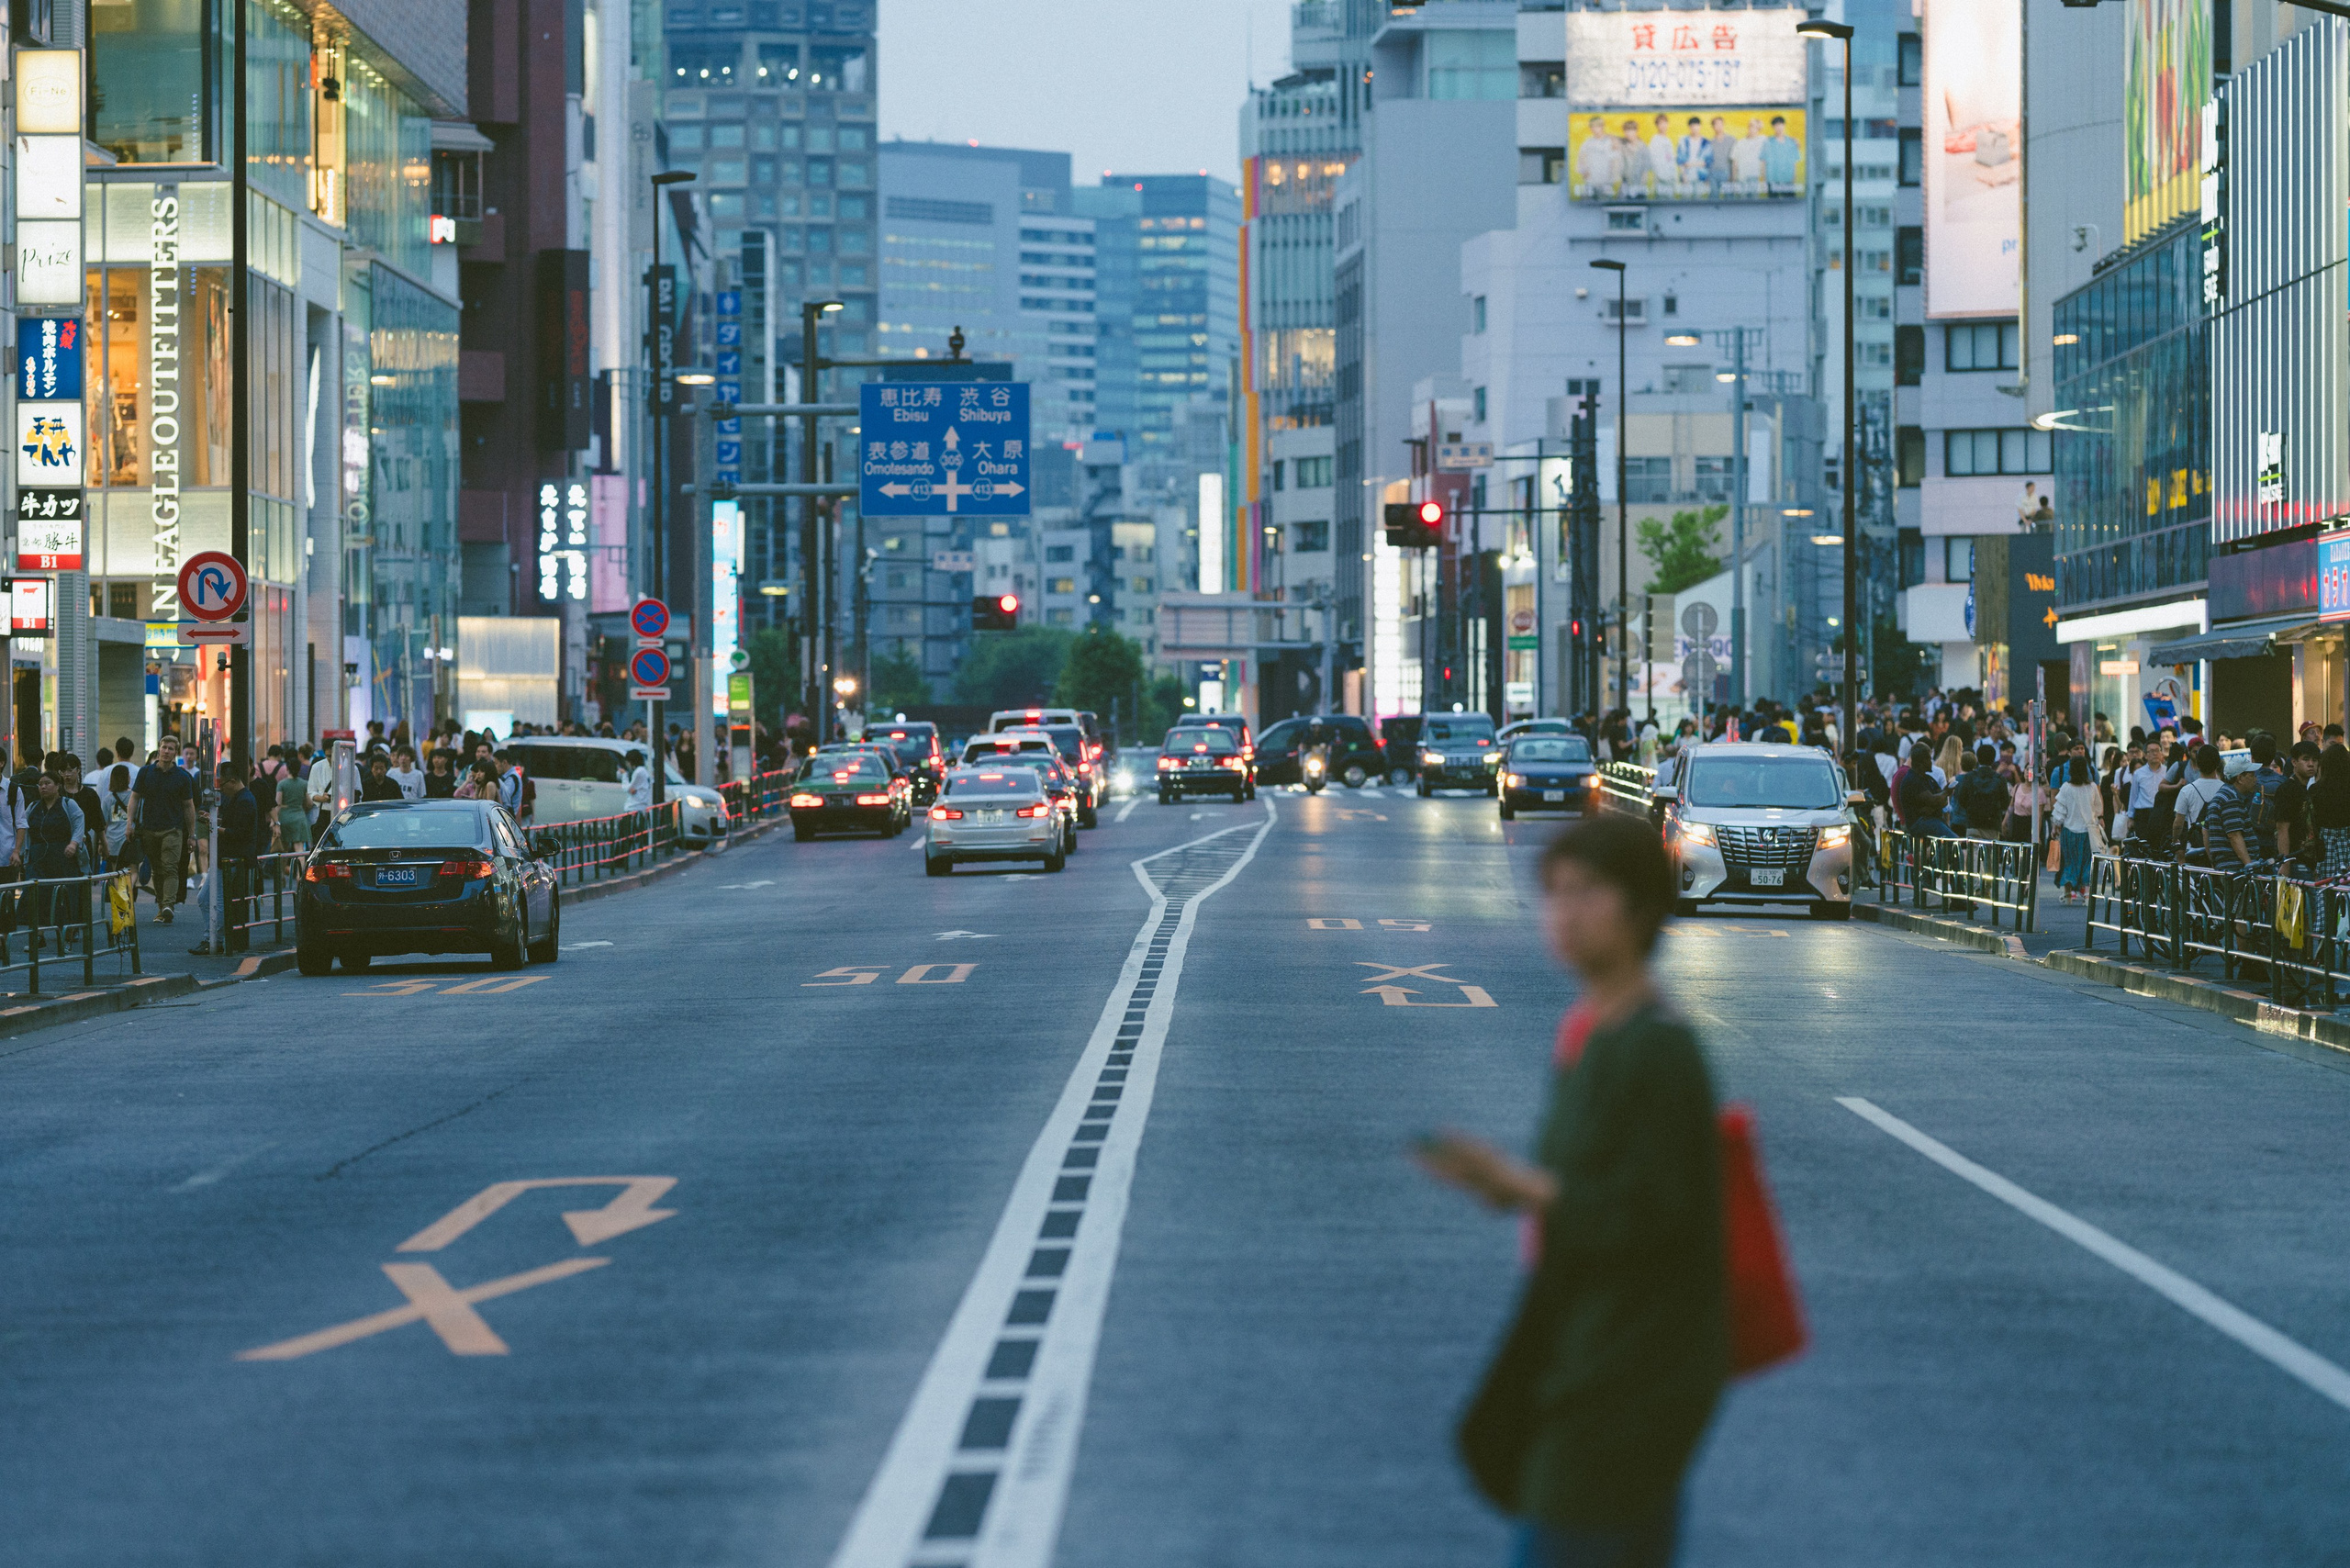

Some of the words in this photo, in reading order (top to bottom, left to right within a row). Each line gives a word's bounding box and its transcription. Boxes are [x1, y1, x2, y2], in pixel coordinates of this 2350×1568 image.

[1632, 24, 1738, 50] 貸広告
[151, 196, 179, 445] OUTFITTERS
[880, 387, 942, 407] 恵比寿
[959, 387, 1011, 407] 渋谷
[893, 409, 929, 422] Ebisu
[959, 408, 1012, 424] Shibuya
[23, 442, 76, 466] てんや
[868, 441, 930, 460] 表参道
[972, 440, 1024, 460] 大原
[941, 454, 962, 465] 305
[864, 462, 934, 476] Omotesando
[978, 461, 1018, 476] Ohara
[912, 485, 930, 495] 413
[974, 485, 991, 495] 413
[21, 492, 80, 519] 牛カツ
[151, 450, 179, 577] EAGLE
[40, 555, 57, 568] B1
[22, 618, 36, 629] B1
[796, 963, 980, 988] 50
[341, 976, 552, 996] 50
